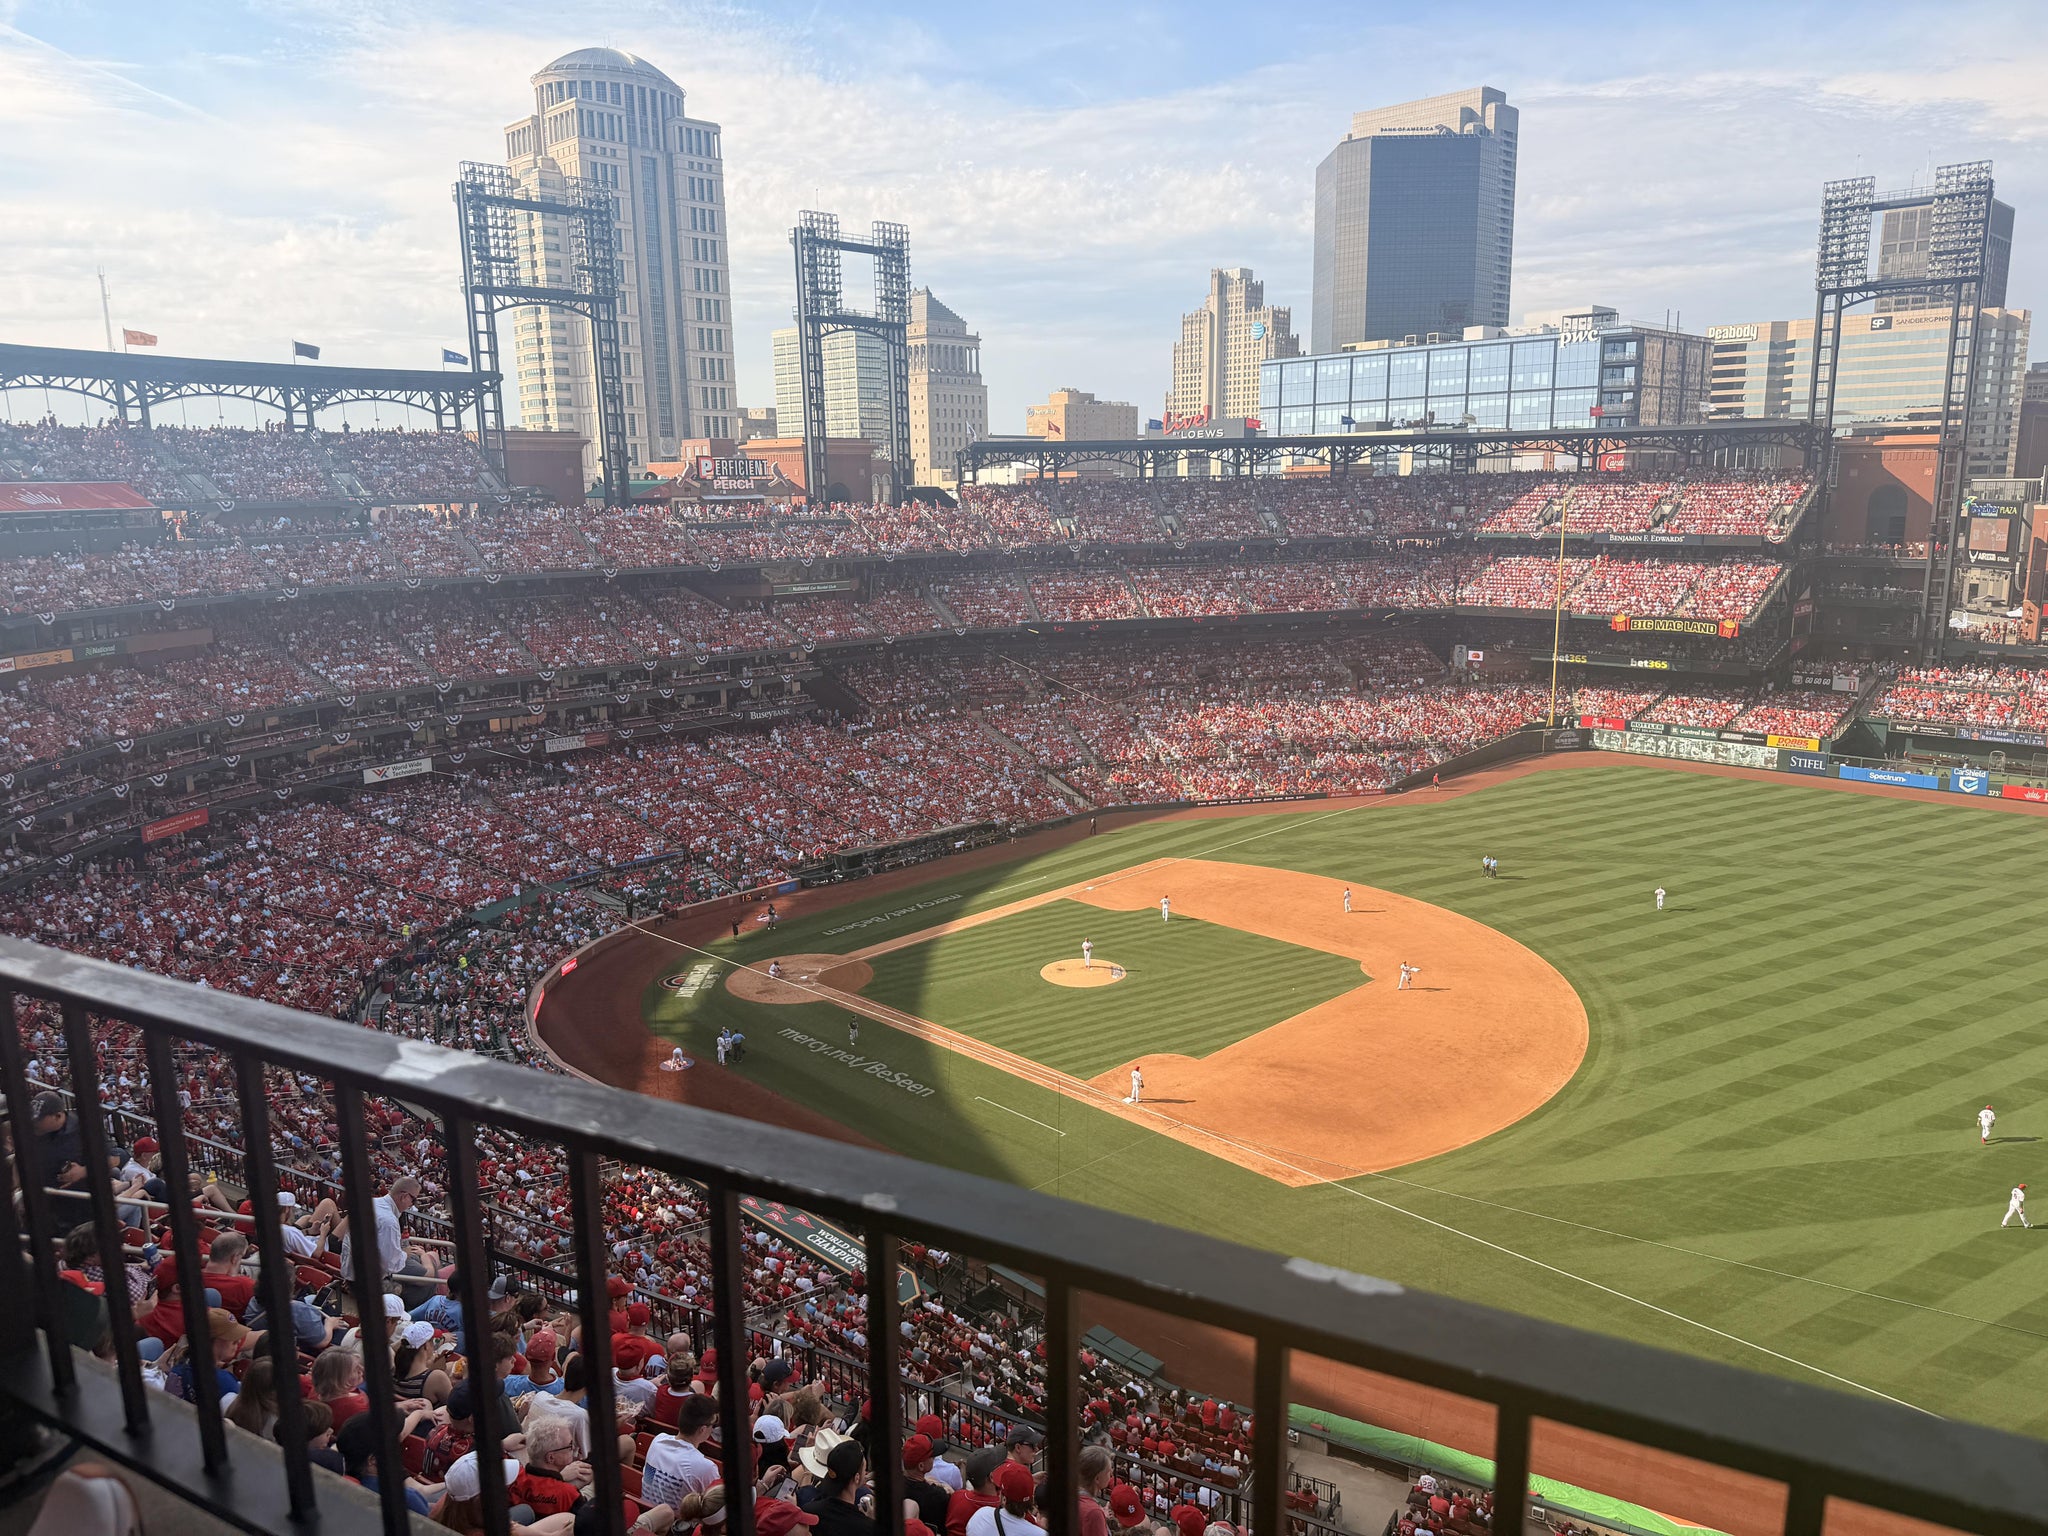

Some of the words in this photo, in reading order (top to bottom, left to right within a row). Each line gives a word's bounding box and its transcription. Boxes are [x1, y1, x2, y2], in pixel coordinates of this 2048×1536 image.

[1560, 329, 1599, 348] pwc
[1708, 324, 1758, 341] Peabody
[1163, 404, 1210, 435] Live!
[1181, 428, 1224, 438] LOEWS
[698, 456, 768, 479] PERFICIENT
[713, 479, 754, 490] PERCH
[1609, 534, 1642, 542] BENJAMIN
[1643, 534, 1649, 542] F.
[1631, 619, 1654, 630] BIG
[1655, 620, 1683, 631] MAC
[1684, 621, 1717, 634] LAND
[1629, 657, 1668, 669] bet365
[1680, 726, 1701, 736] Central
[1701, 730, 1717, 738] Bank
[1896, 724, 1913, 733] Mercy
[1777, 737, 1809, 747] DOBBS
[392, 763, 408, 772] World
[1790, 755, 1826, 770] STIFEL
[393, 767, 423, 777] Technology
[1868, 771, 1904, 783] Spectrum
[1953, 767, 1986, 779] CarShield
[822, 893, 963, 936] mercy.net/BeSeen
[776, 1027, 935, 1098] mercy.net/BeSeen
[817, 1228, 850, 1250] WORLD
[848, 1247, 868, 1262] SER
